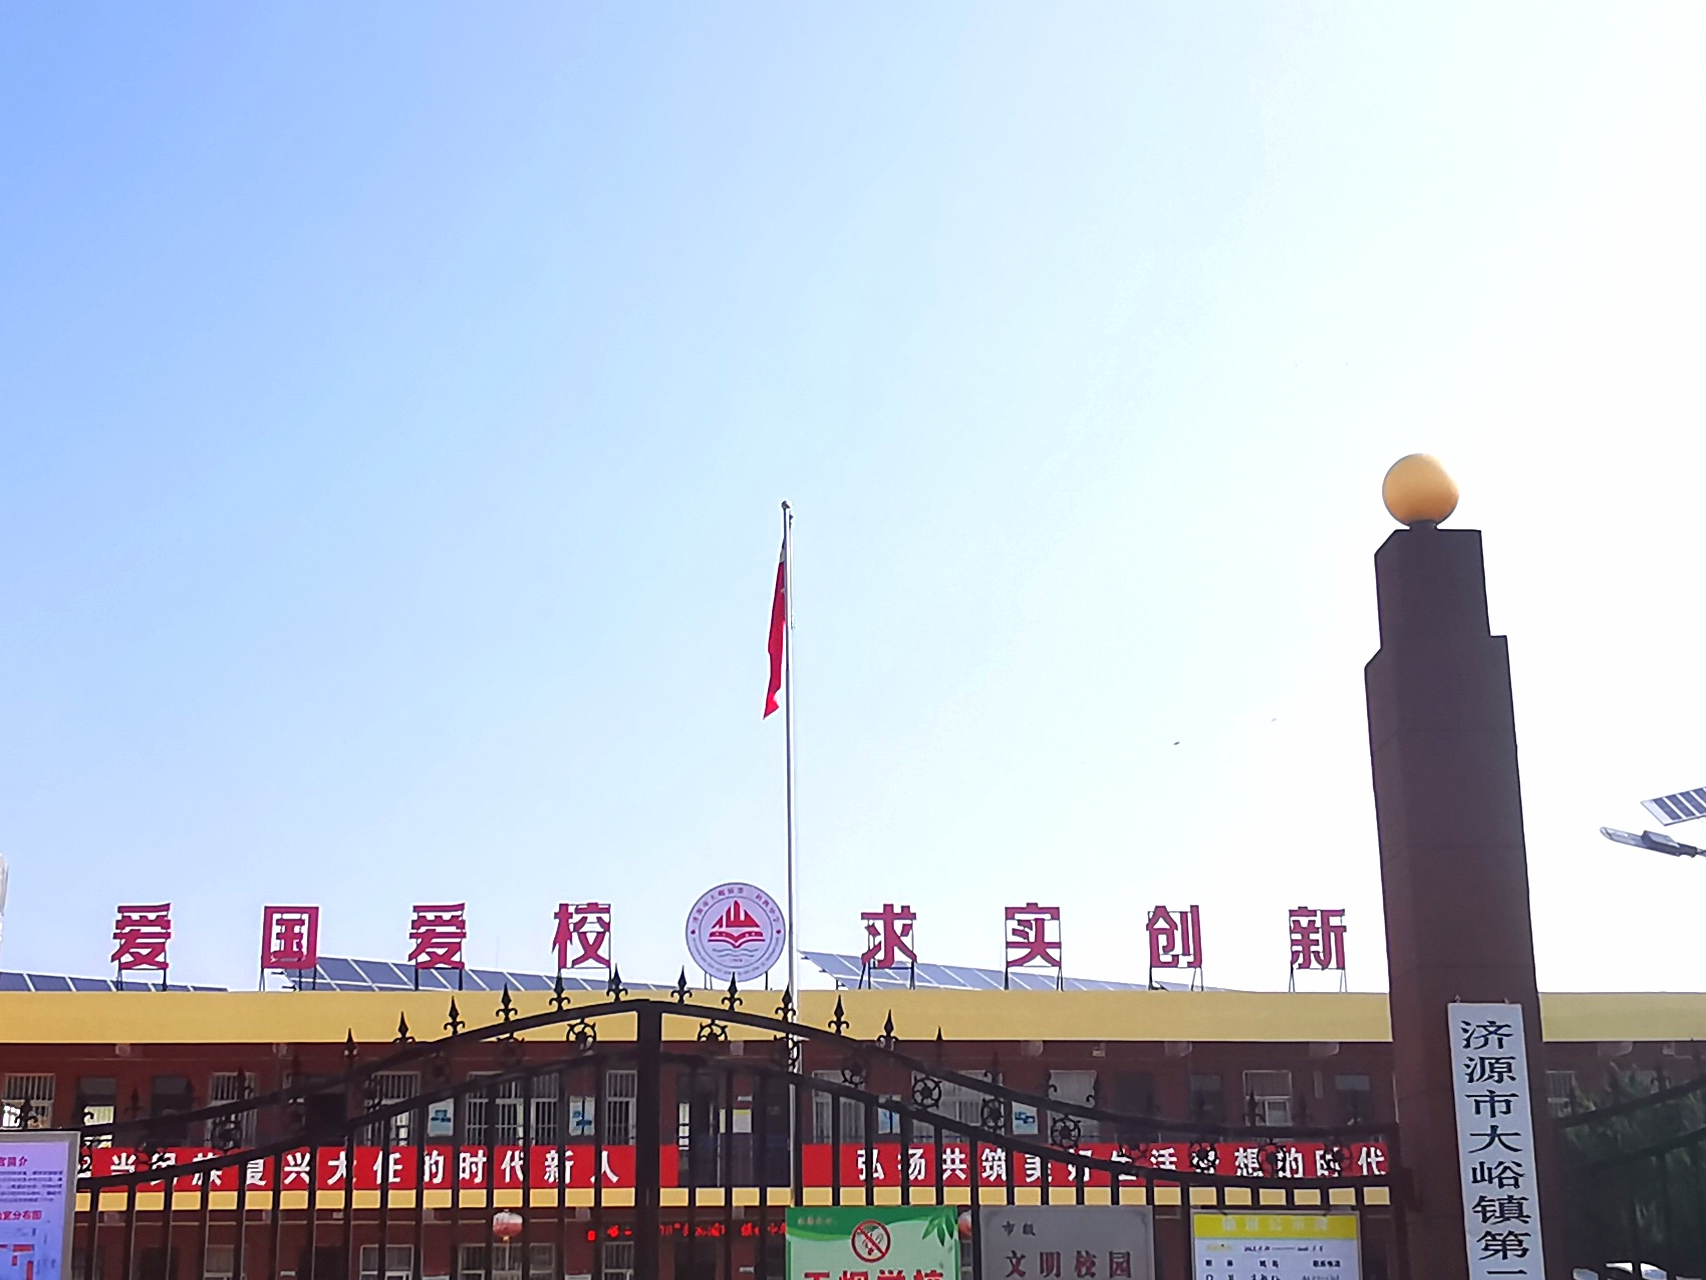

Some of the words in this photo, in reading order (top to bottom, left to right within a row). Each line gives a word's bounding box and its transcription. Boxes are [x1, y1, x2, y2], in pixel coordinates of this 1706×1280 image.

[111, 901, 612, 971] 爱国爱校
[860, 902, 1348, 971] 求实创新
[1002, 1221, 1036, 1236] 市级
[1005, 1250, 1132, 1279] 文明校园
